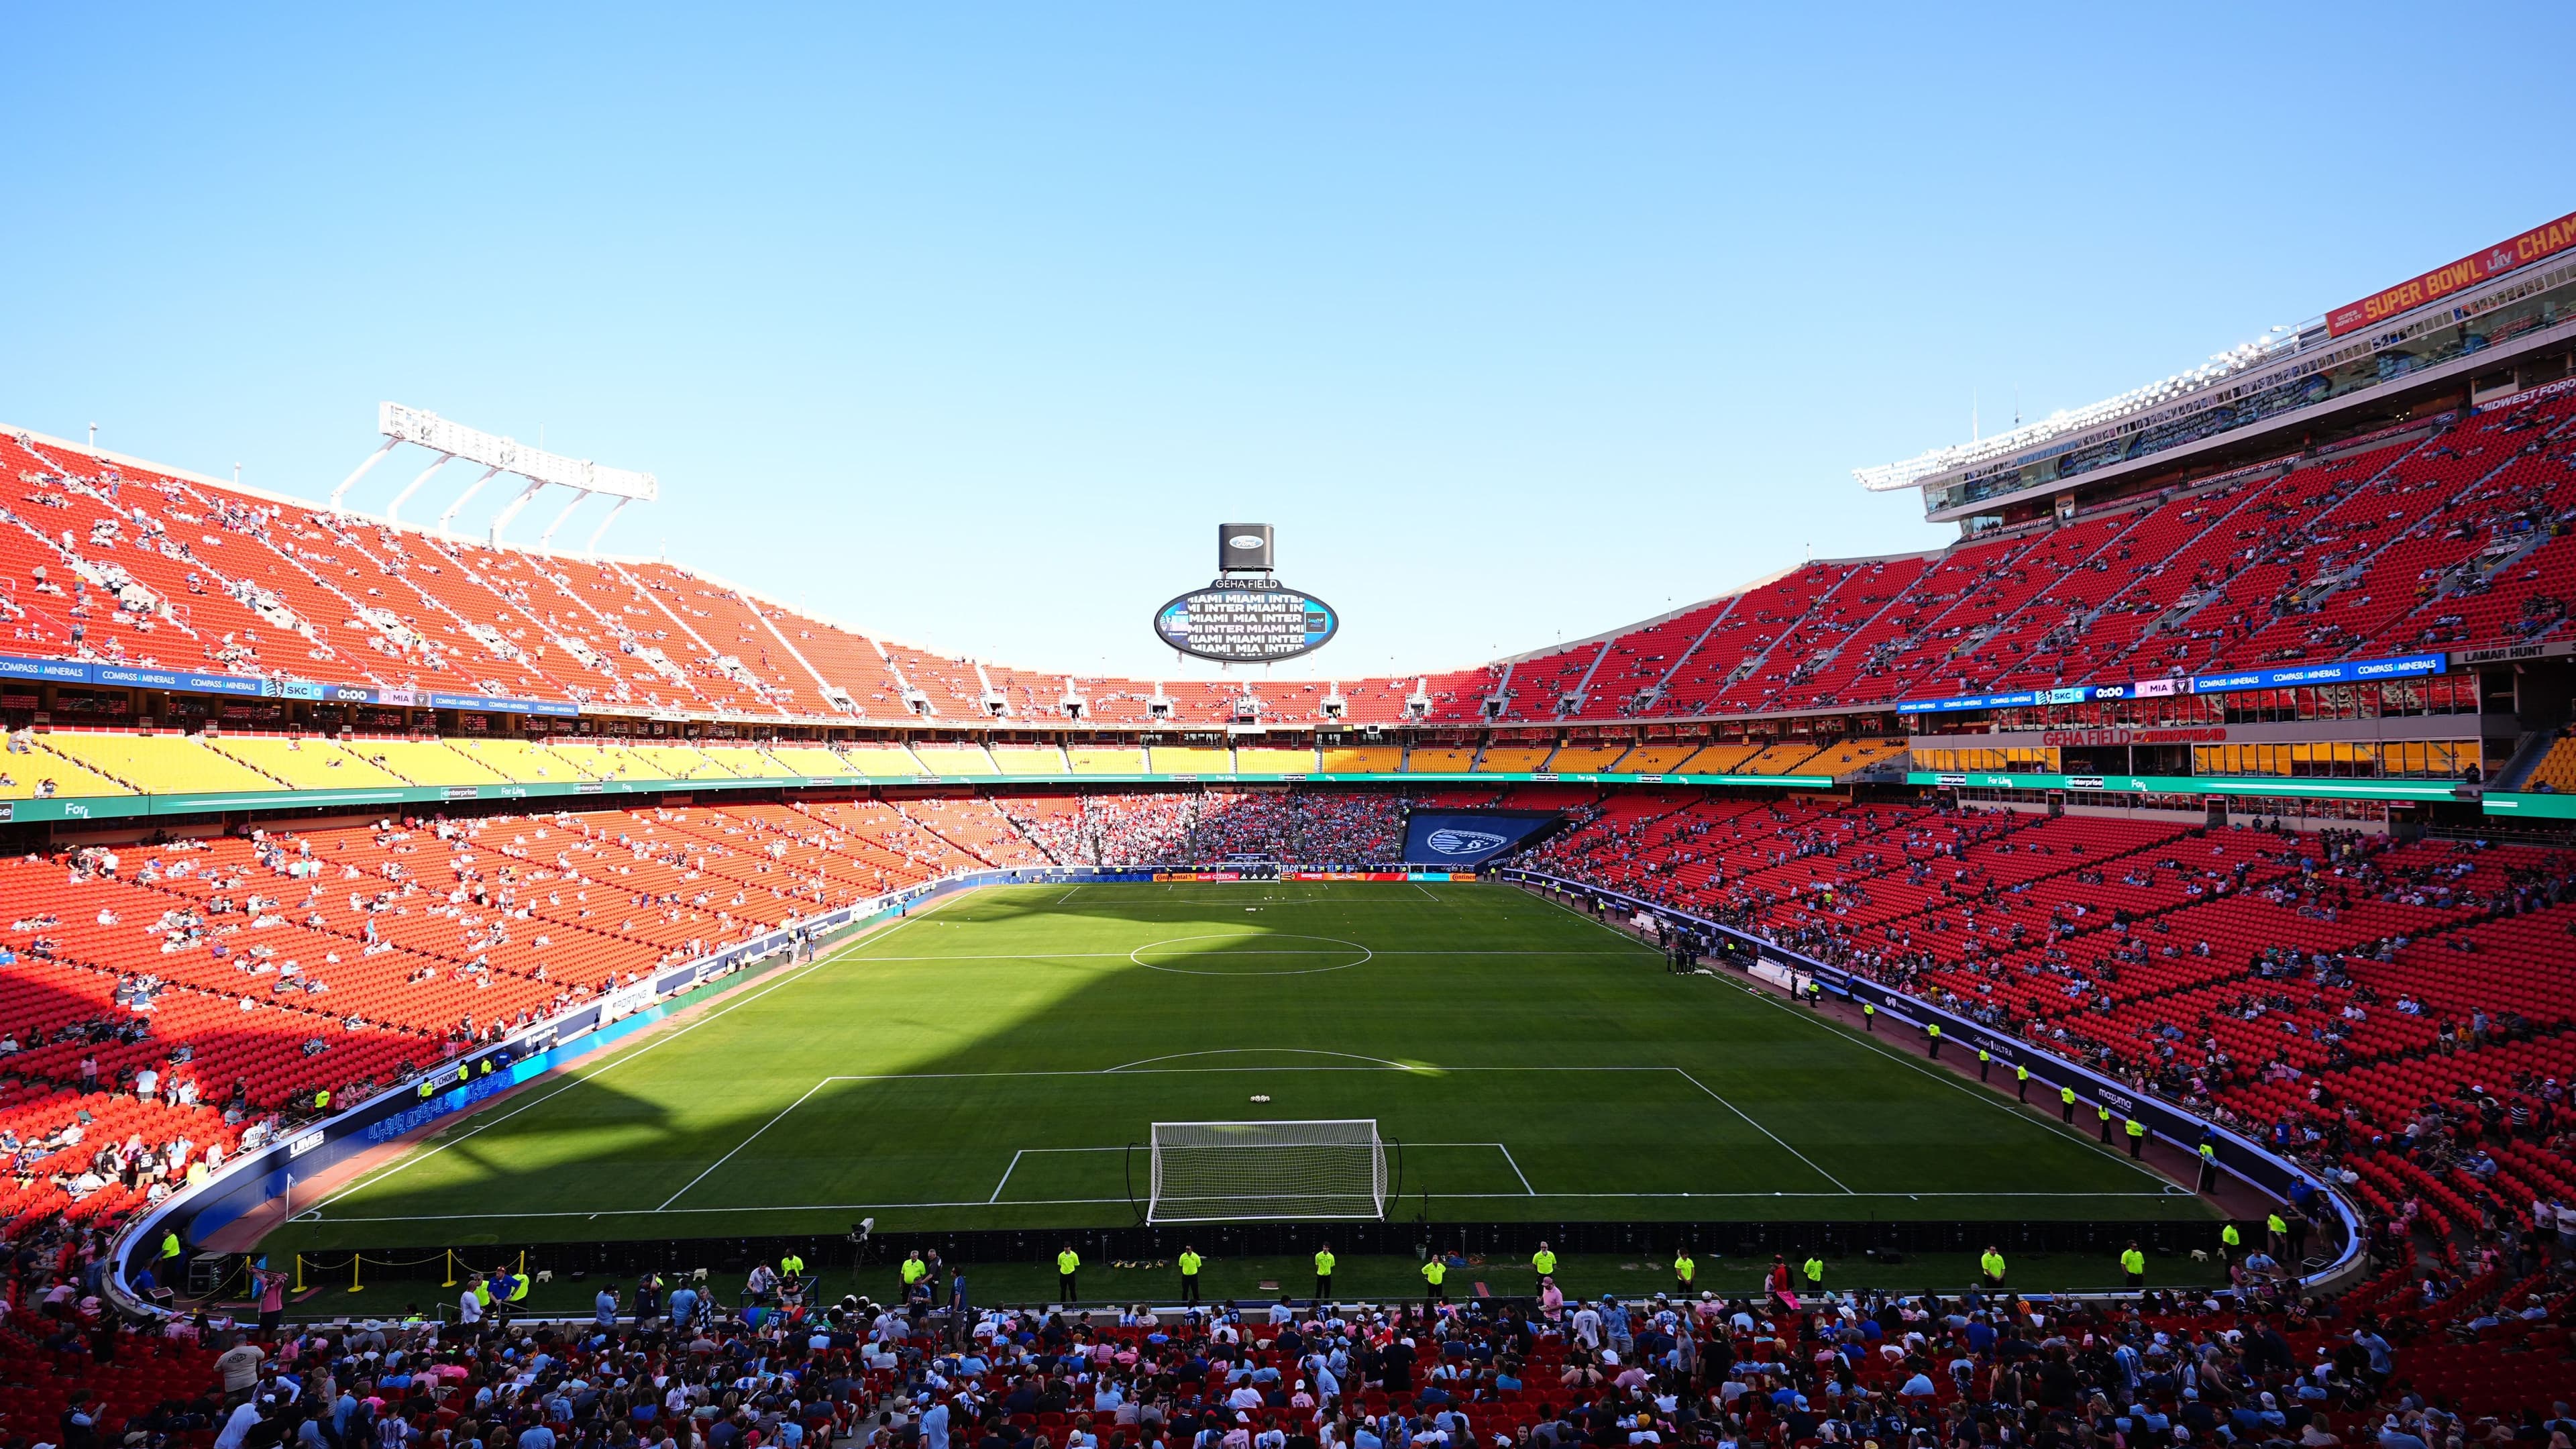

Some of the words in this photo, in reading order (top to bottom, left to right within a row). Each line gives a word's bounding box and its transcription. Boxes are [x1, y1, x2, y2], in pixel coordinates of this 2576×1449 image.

[2365, 281, 2423, 319] SUPER
[2426, 259, 2482, 297] BOWL
[2478, 389, 2537, 413] MIDWEST
[1216, 580, 1246, 588] GEHA
[1248, 580, 1277, 588] FIELD
[1226, 594, 1265, 603] MIAMI
[1205, 604, 1244, 612] INTER
[1246, 604, 1286, 612] MIAMI
[1289, 604, 1305, 612] IN
[1189, 614, 1228, 623] MIAMI
[1233, 614, 1258, 623] MIA
[1262, 614, 1302, 623] INTER
[1205, 625, 1244, 633] INTER
[1246, 625, 1286, 633] MIAMI
[1226, 635, 1265, 643] MIAMI
[1236, 644, 1260, 653] MIA
[2465, 649, 2507, 662] LAMAR
[2510, 645, 2544, 658] HUNT
[44, 665, 84, 677] MINERALS
[2357, 663, 2393, 675] COMPASS
[2398, 659, 2436, 671] MINERALS
[102, 670, 138, 682] COMPASS
[142, 674, 175, 685] MINERALS
[2273, 672, 2304, 682] COMPASS
[2308, 668, 2341, 679] MINERALS
[191, 678, 222, 688] COMPASS
[226, 682, 256, 691] MINERALS
[2199, 680, 2226, 688] COMPASS
[2230, 676, 2259, 685] MINERALS
[287, 686, 308, 696] SKC
[313, 687, 321, 696] 0
[337, 688, 367, 700] 0:00
[381, 692, 388, 701] 0
[393, 694, 409, 702] MIA
[2054, 692, 2071, 700] SKC
[2076, 690, 2082, 698] 0
[2096, 686, 2124, 698] 0:00
[2150, 684, 2167, 692] MIA
[2043, 730, 2085, 747] GEHA
[2088, 729, 2131, 746] FIELD
[2144, 728, 2226, 743] ARROWHEAD
[2066, 778, 2102, 788] enterprise
[441, 788, 477, 798] enterprise
[501, 787, 511, 795] For
[612, 989, 647, 1009] SPORTING
[1994, 1041, 2013, 1058] ULTRA
[439, 1071, 459, 1084] CHOPP
[2098, 1087, 2132, 1109] mazuma
[290, 1129, 325, 1155] UMB
[767, 1316, 780, 1327] 18
[1231, 1313, 1238, 1324] 9
[1584, 1320, 1591, 1332] 7
[1890, 1421, 1902, 1435] 9
[1232, 1441, 1247, 1449] 10
